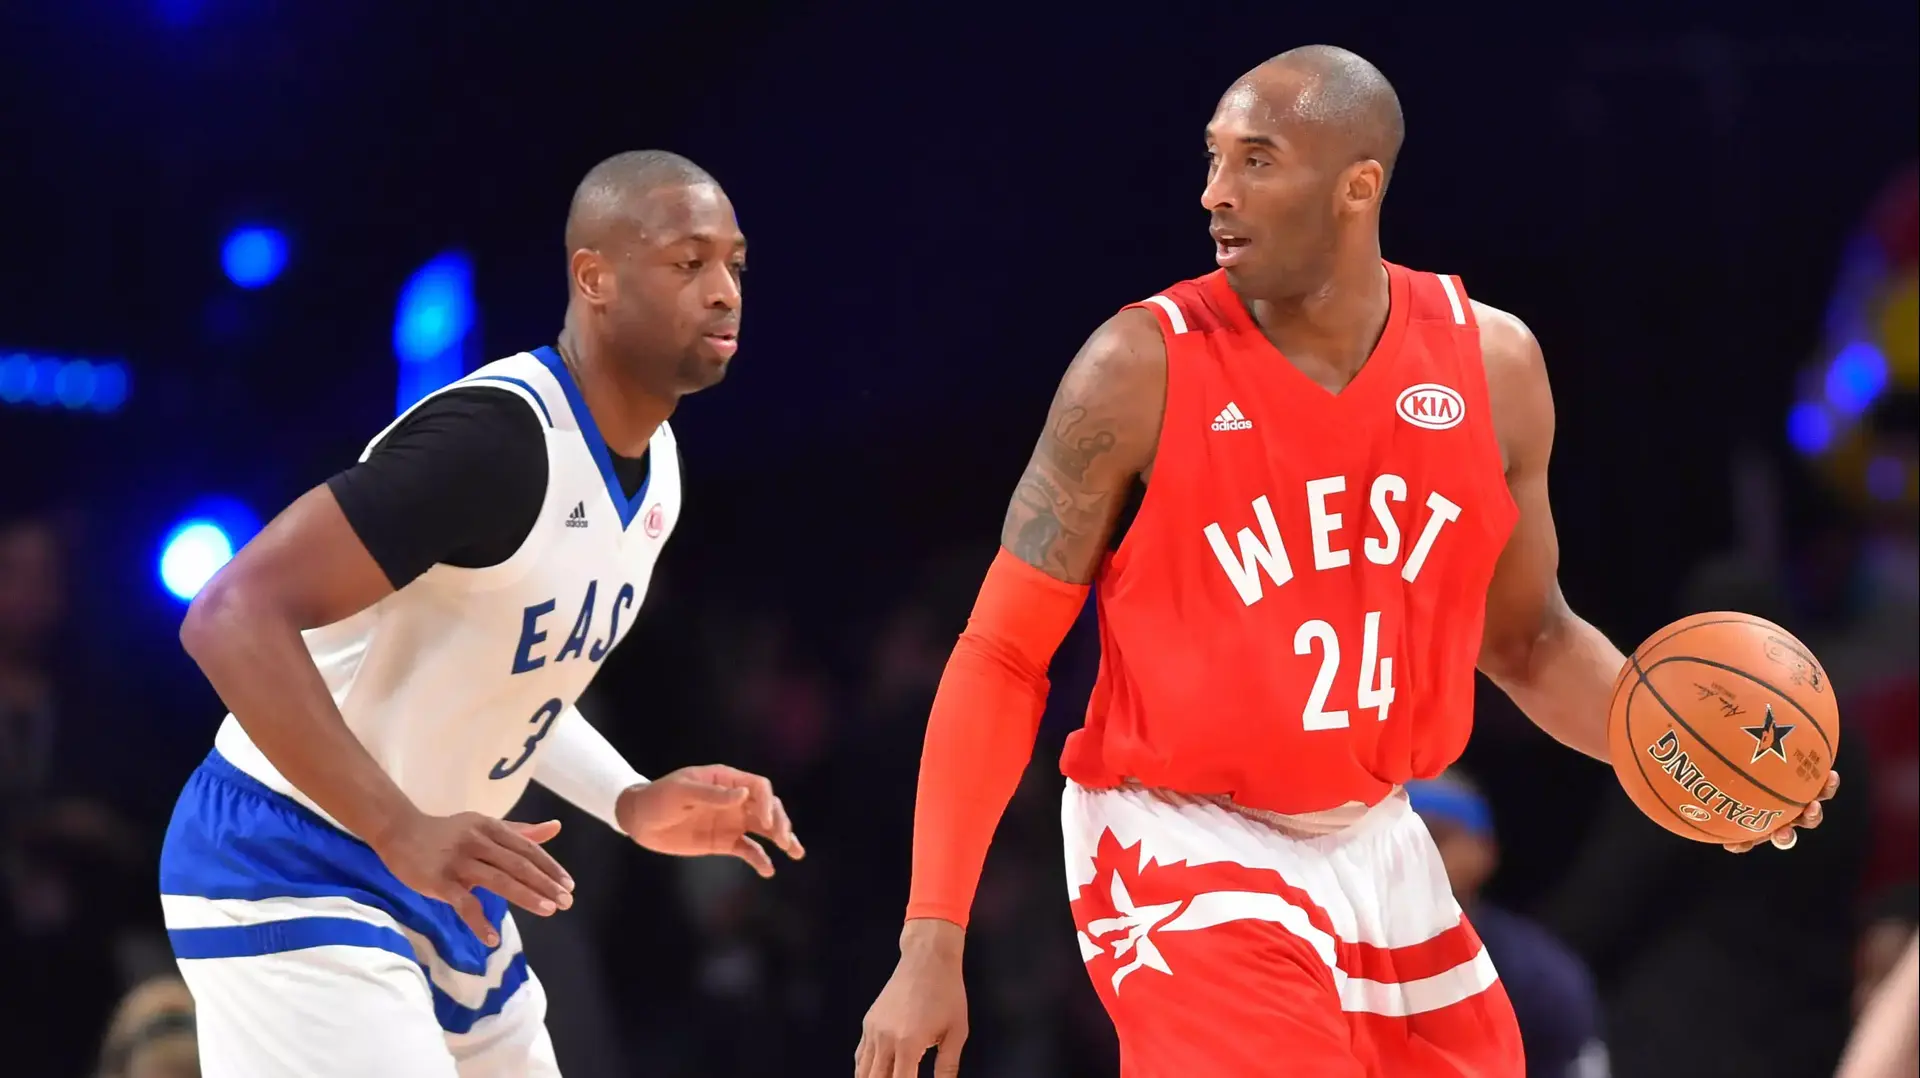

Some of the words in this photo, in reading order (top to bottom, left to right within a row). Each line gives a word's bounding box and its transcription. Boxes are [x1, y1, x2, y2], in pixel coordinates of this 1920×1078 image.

[1211, 419, 1252, 431] adidas
[1412, 395, 1452, 418] KIA
[565, 519, 588, 528] adidas
[1203, 473, 1462, 607] WEST
[1293, 611, 1396, 731] 24
[488, 697, 562, 780] 3
[1647, 729, 1783, 832] SPALDING
